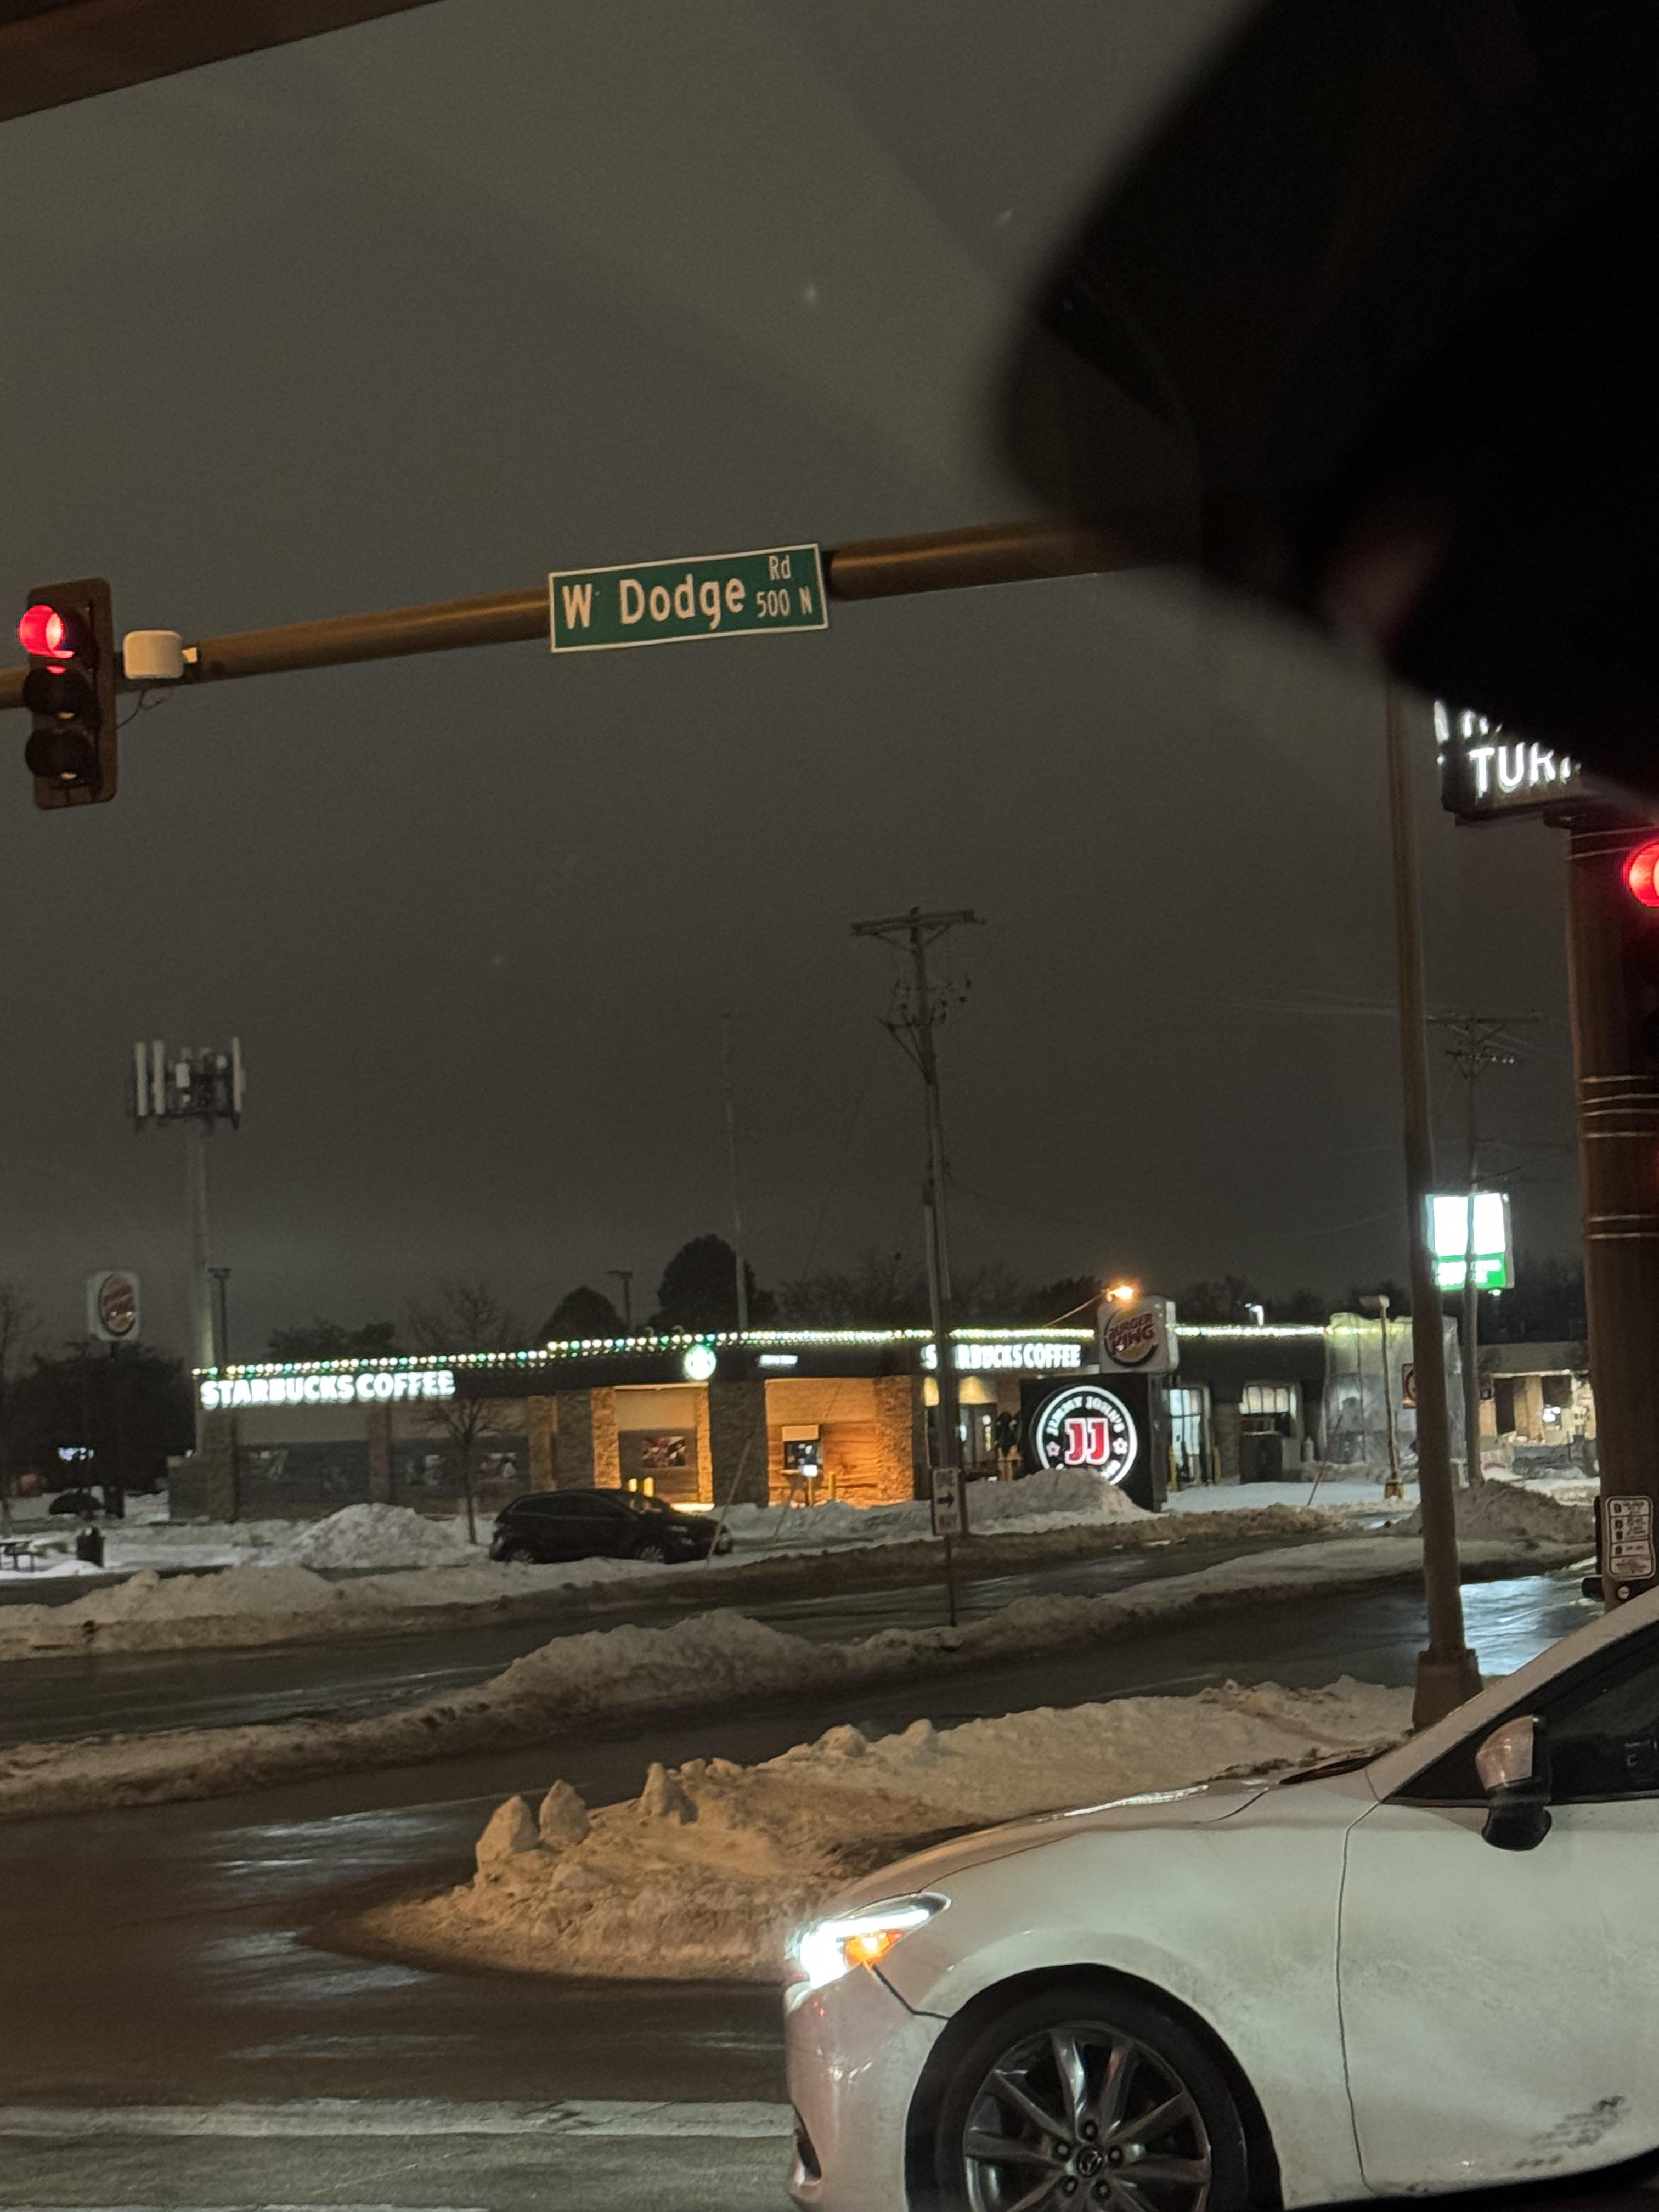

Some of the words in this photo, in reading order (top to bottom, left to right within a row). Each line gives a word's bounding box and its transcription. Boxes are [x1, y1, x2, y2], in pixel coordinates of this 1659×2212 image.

[562, 583, 592, 629] W
[619, 573, 746, 630] Dodge
[768, 554, 791, 581] Rd
[756, 588, 791, 619] 500
[799, 586, 813, 615] N
[920, 1344, 1022, 1370] SRBUCKS
[1023, 1343, 1081, 1369] COFFEE
[1111, 1323, 1155, 1356] KING
[200, 1374, 356, 1409] STARBUCKS
[356, 1369, 456, 1401] COFFEE
[1064, 1417, 1110, 1466] JJ
